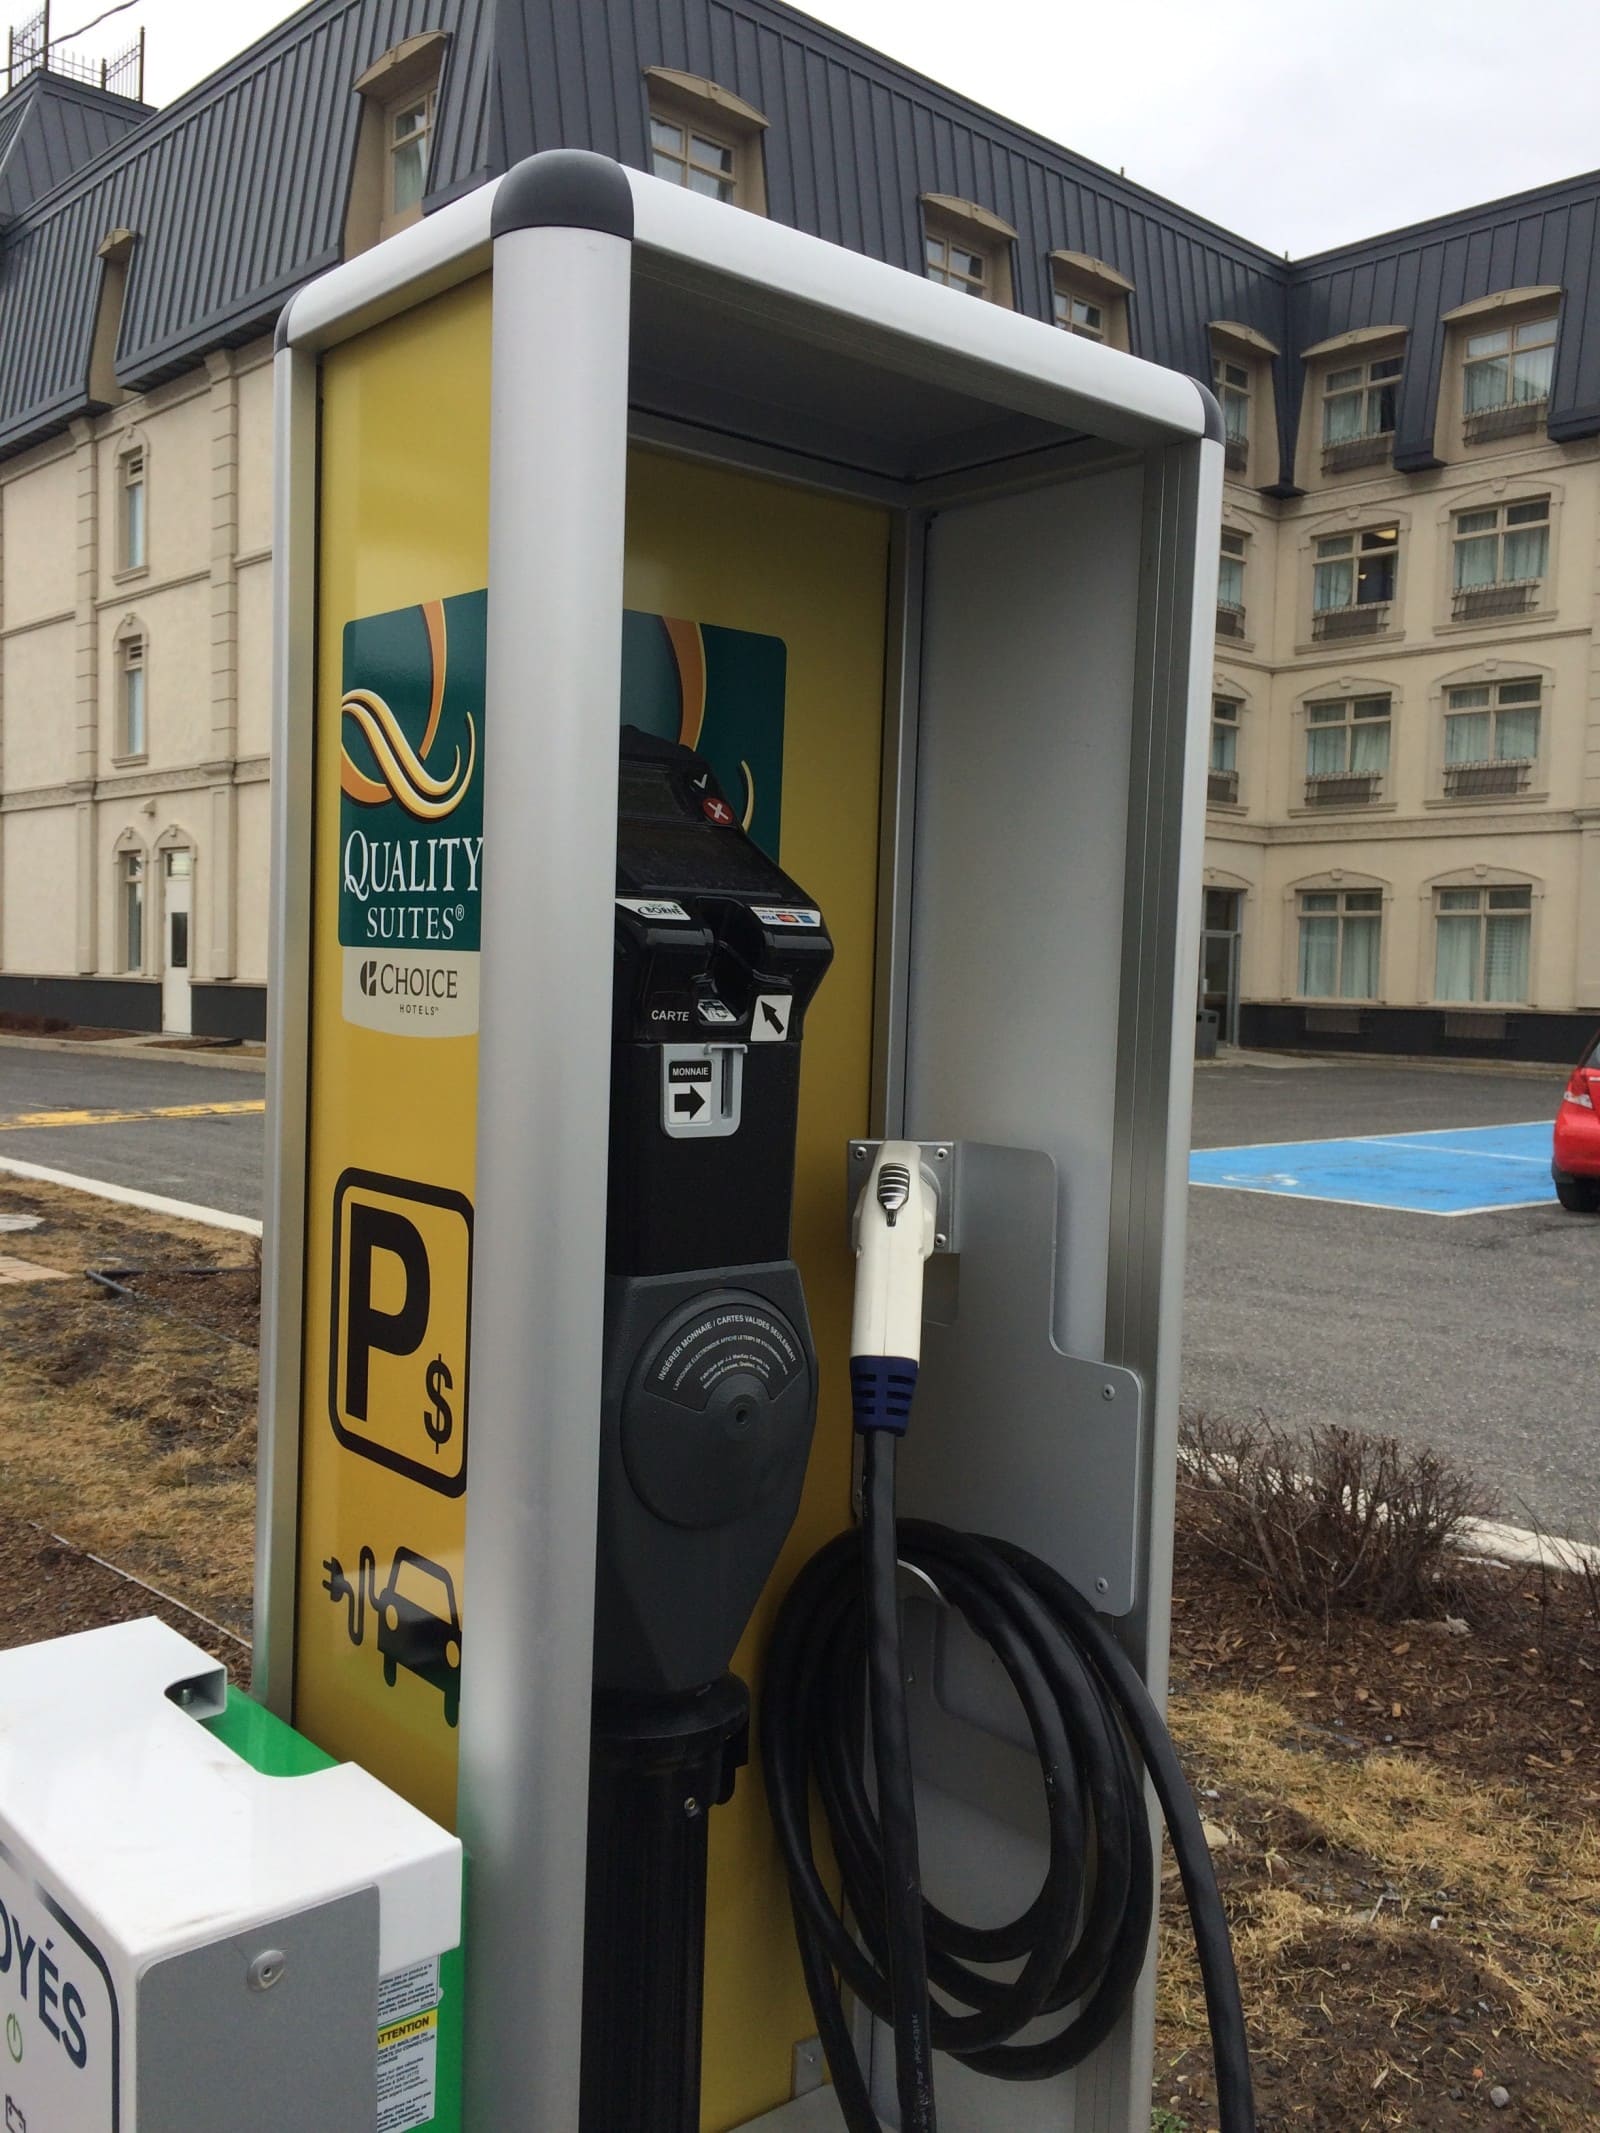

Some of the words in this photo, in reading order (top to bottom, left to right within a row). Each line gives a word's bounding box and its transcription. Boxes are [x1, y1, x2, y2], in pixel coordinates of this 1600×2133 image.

[344, 830, 484, 902] QUALITY
[380, 963, 458, 999] CHOICE
[651, 1010, 690, 1022] CARTE
[672, 1067, 709, 1076] MONNAIE
[345, 1202, 430, 1422] P
[658, 1345, 683, 1382] INSÉRER
[680, 1321, 713, 1349] MONNAIE
[716, 1314, 744, 1326] CARTES
[744, 1315, 770, 1330] VALIDES
[769, 1326, 797, 1362] SEULEMENT
